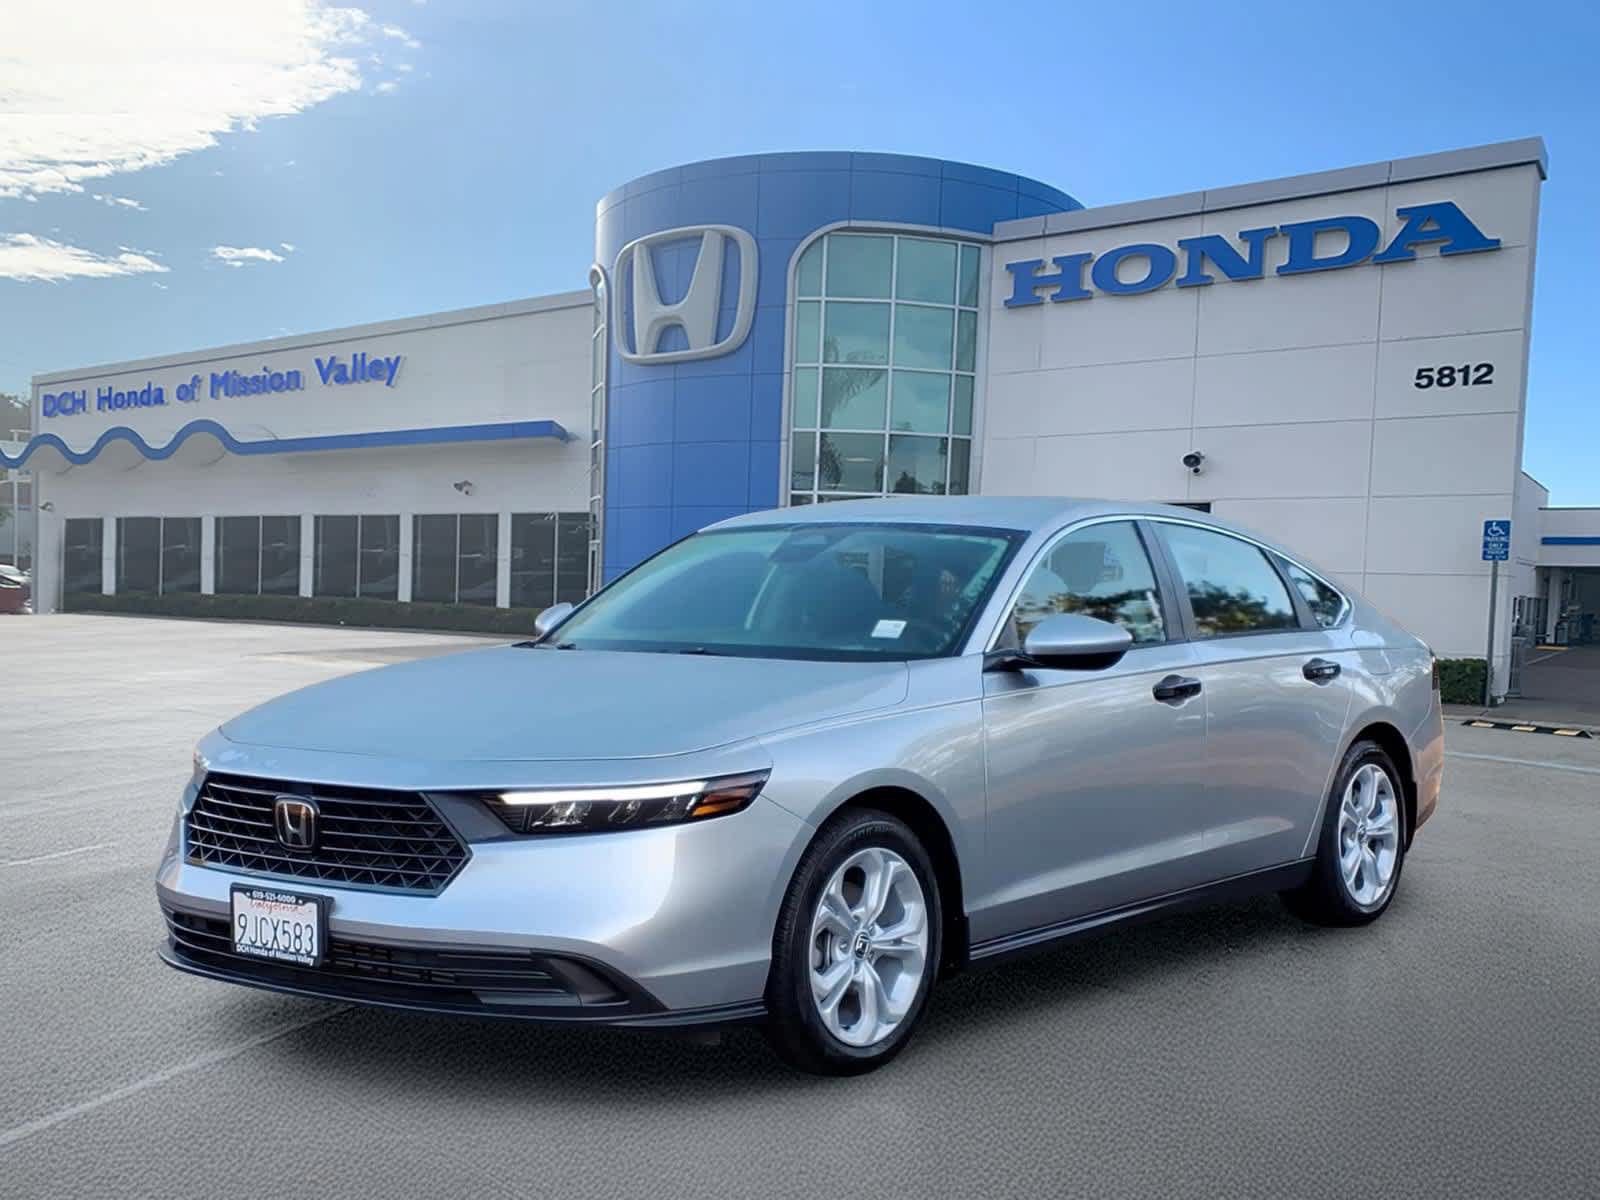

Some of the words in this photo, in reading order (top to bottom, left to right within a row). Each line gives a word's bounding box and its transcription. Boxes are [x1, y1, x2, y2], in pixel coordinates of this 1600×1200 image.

[1004, 201, 1501, 308] HONDA
[43, 390, 87, 417] DCH
[97, 382, 165, 411] Honda
[176, 374, 203, 402] of
[210, 366, 302, 399] Mission
[315, 352, 401, 387] Valley
[1414, 363, 1494, 389] 5812
[238, 913, 314, 955] 9JCX583
